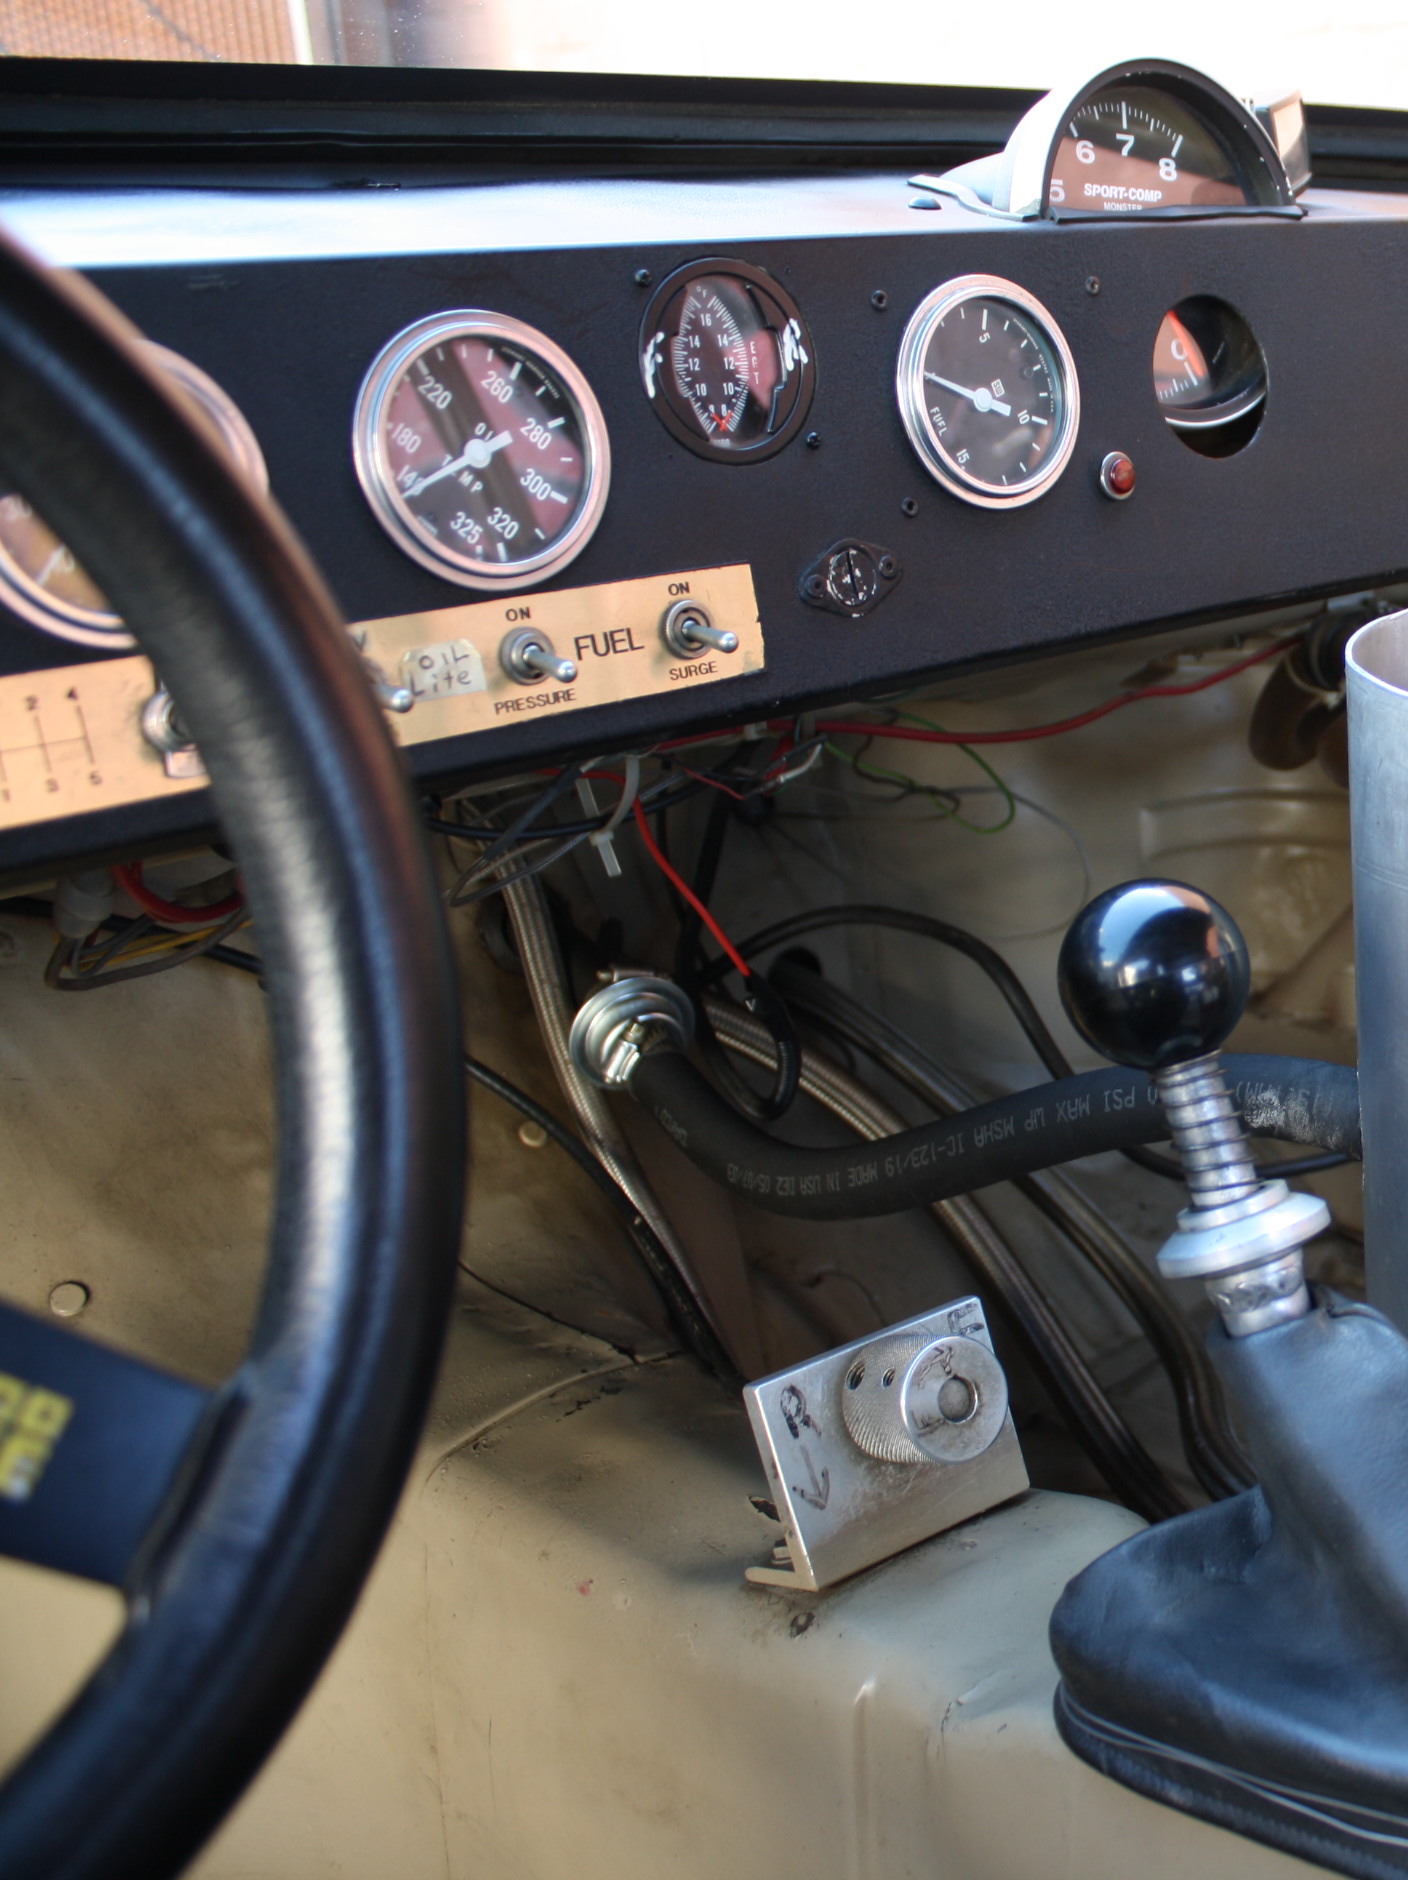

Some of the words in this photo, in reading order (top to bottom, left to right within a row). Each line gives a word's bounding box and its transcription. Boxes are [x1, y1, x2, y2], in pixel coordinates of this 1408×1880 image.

[1075, 140, 1096, 164] 6
[1115, 133, 1135, 156] 7
[1159, 157, 1178, 181] 8
[1050, 179, 1065, 202] 5
[1084, 183, 1162, 203] SPORT-COMP
[701, 313, 712, 326] 16
[689, 335, 701, 348] 14
[717, 334, 729, 347] 14
[979, 332, 992, 343] 5
[689, 359, 701, 371] 12
[724, 357, 735, 370] 12
[418, 375, 453, 410] 220
[481, 371, 514, 404] 260
[696, 384, 707, 396] 10
[723, 383, 734, 396] 10
[721, 404, 727, 417] 8
[1017, 410, 1030, 425] 10
[391, 422, 422, 454] 180
[520, 418, 552, 450] 280
[956, 447, 970, 465] 15
[520, 468, 552, 501] 300
[450, 511, 483, 544] 325
[487, 507, 519, 540] 320
[668, 582, 691, 596] ON
[505, 607, 531, 622] ON
[574, 627, 645, 661] FUEL
[418, 644, 470, 670] OIL
[669, 661, 719, 681] SURGE
[409, 670, 472, 697] Lite
[494, 688, 577, 715] PRESSURE
[1056, 1094, 1090, 1123] MAX
[1104, 1086, 1136, 1113] PSI
[1024, 1107, 1045, 1131] WP
[974, 1116, 1015, 1148] MSHA
[885, 1132, 964, 1177] IC-123/19
[800, 1174, 822, 1196] USA
[826, 1171, 840, 1192] IN
[848, 1161, 878, 1187] MADE
